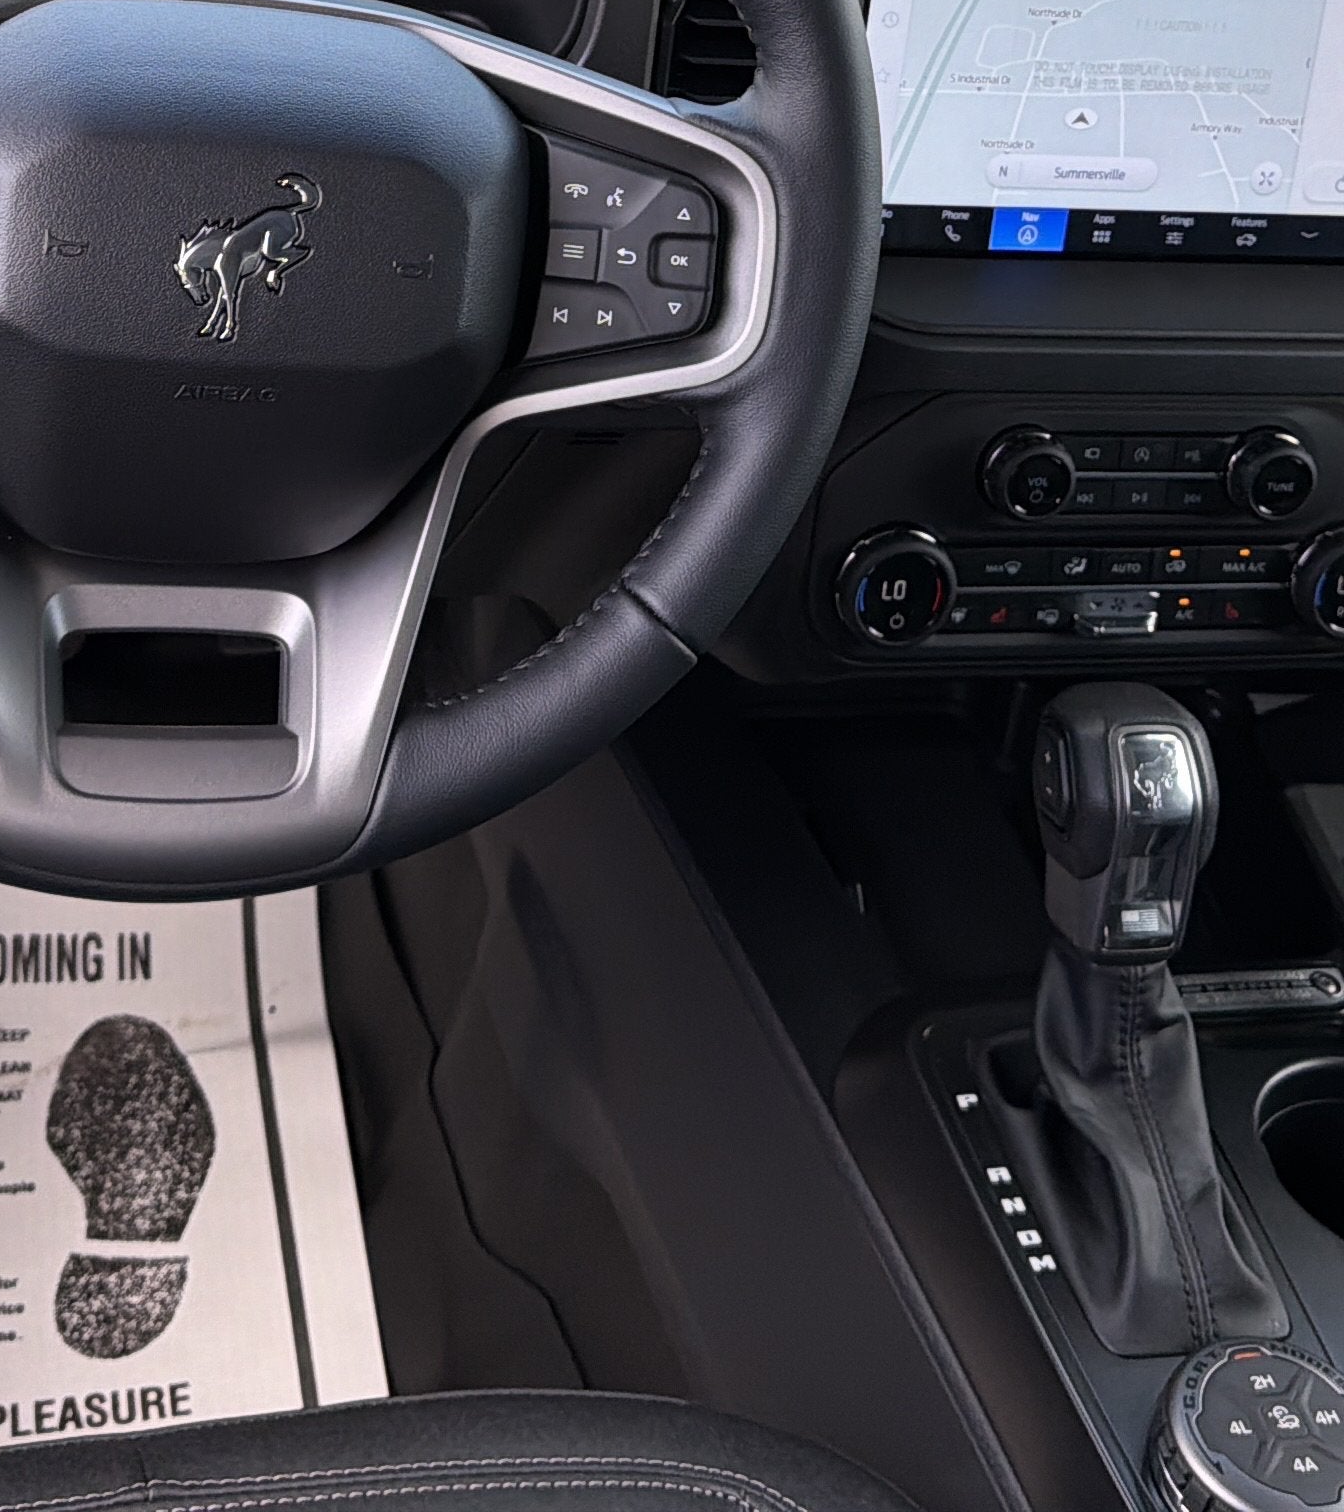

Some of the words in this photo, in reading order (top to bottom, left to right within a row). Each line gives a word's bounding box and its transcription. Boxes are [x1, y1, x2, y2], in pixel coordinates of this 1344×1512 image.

[1028, 7, 1071, 18] Northside
[1072, 9, 1083, 19] Dr
[956, 74, 999, 85] Industrial
[981, 138, 1023, 149] Northside
[999, 166, 1008, 177] N
[1054, 167, 1126, 181] Summersville
[941, 209, 970, 222] Phone
[1021, 211, 1040, 223] Nav
[1093, 213, 1116, 226] Apps
[1159, 215, 1195, 228] Settings
[1231, 216, 1268, 228] Features
[670, 254, 689, 267] OK
[1028, 476, 1048, 488] VOL
[1266, 481, 1295, 493] TUNE
[1111, 561, 1141, 574] AUTO
[1222, 561, 1246, 573] MAX
[1248, 561, 1266, 574] A/C
[881, 579, 907, 601] LO
[117, 931, 153, 982] IN
[956, 1093, 979, 1111] P
[986, 1166, 1012, 1185] R
[1002, 1196, 1026, 1214] N
[1028, 1254, 1057, 1272] M
[1250, 1374, 1276, 1391] 2H
[1315, 1410, 1341, 1426] 4H
[1229, 1420, 1253, 1436] 4L
[1293, 1457, 1319, 1473] 4A
